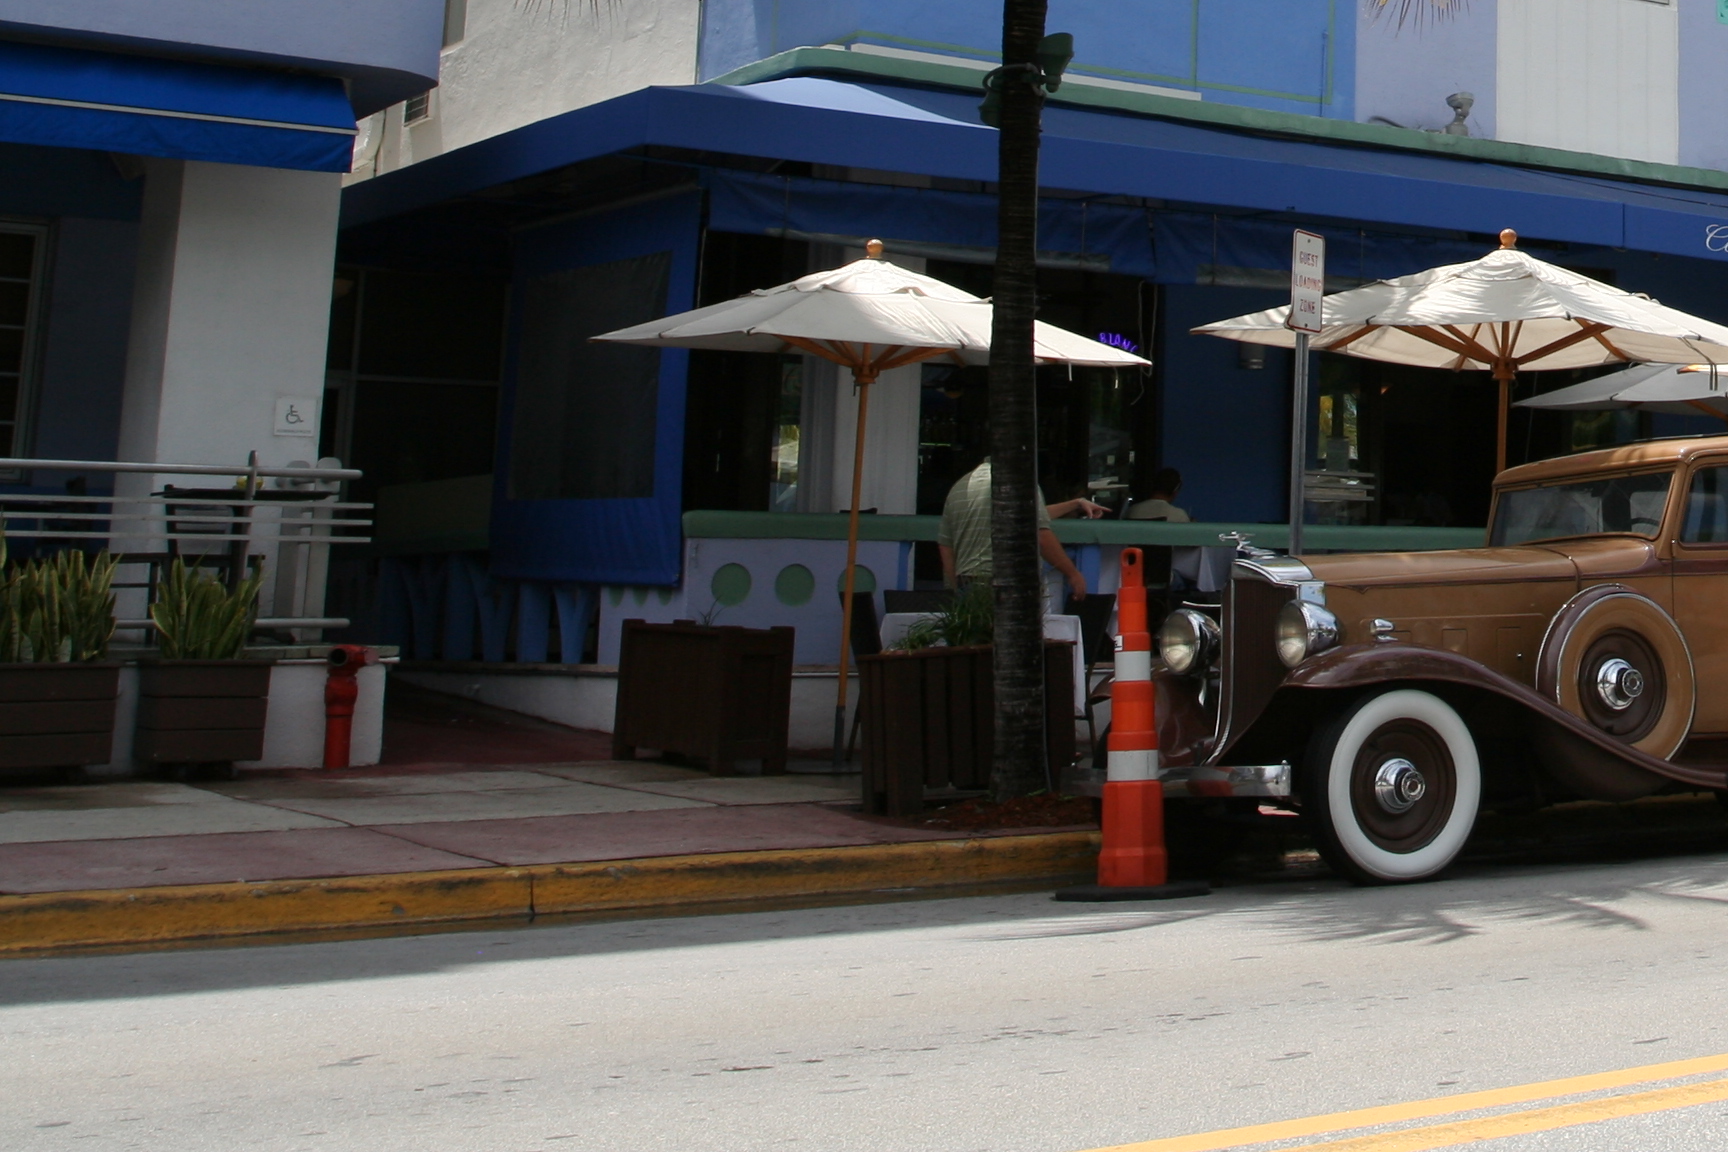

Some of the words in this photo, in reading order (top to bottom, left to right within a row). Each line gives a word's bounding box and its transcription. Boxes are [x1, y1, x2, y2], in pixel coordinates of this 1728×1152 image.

[1299, 250, 1319, 268] GUEST
[1295, 273, 1322, 292] LOADING
[1299, 298, 1316, 315] ZONE
